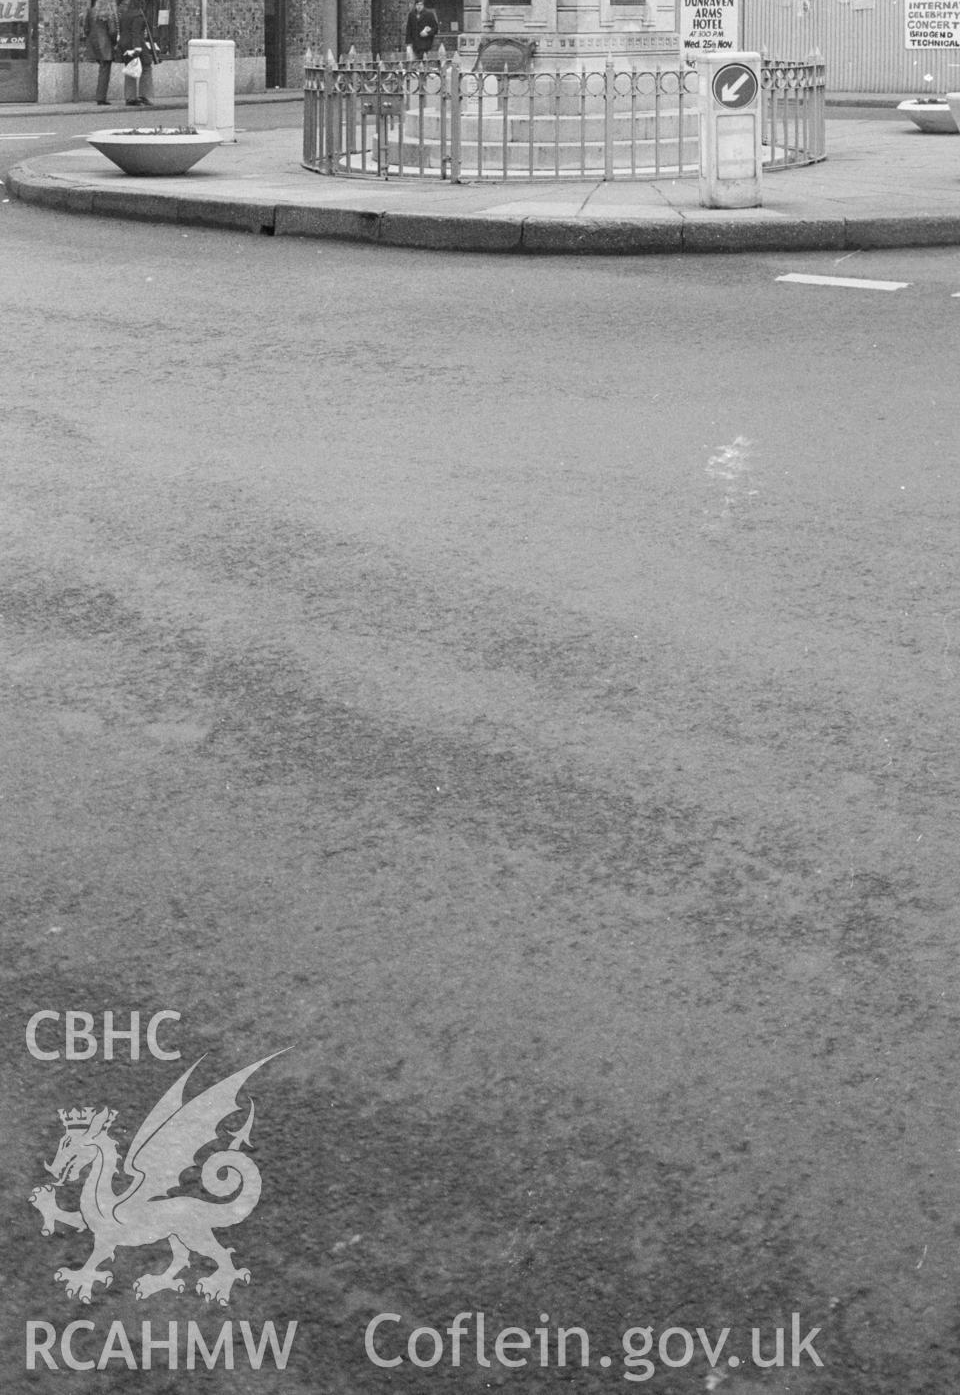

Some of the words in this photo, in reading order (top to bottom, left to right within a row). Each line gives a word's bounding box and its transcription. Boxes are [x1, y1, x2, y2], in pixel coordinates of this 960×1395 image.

[695, 7, 722, 18] ARMS
[908, 11, 960, 20] CELEBRITY
[692, 18, 723, 30] HOTEL
[907, 20, 960, 30] CONCERT
[909, 31, 953, 39] BRIDGEND
[10, 36, 26, 44] ON
[910, 39, 960, 47] TECHNICAL
